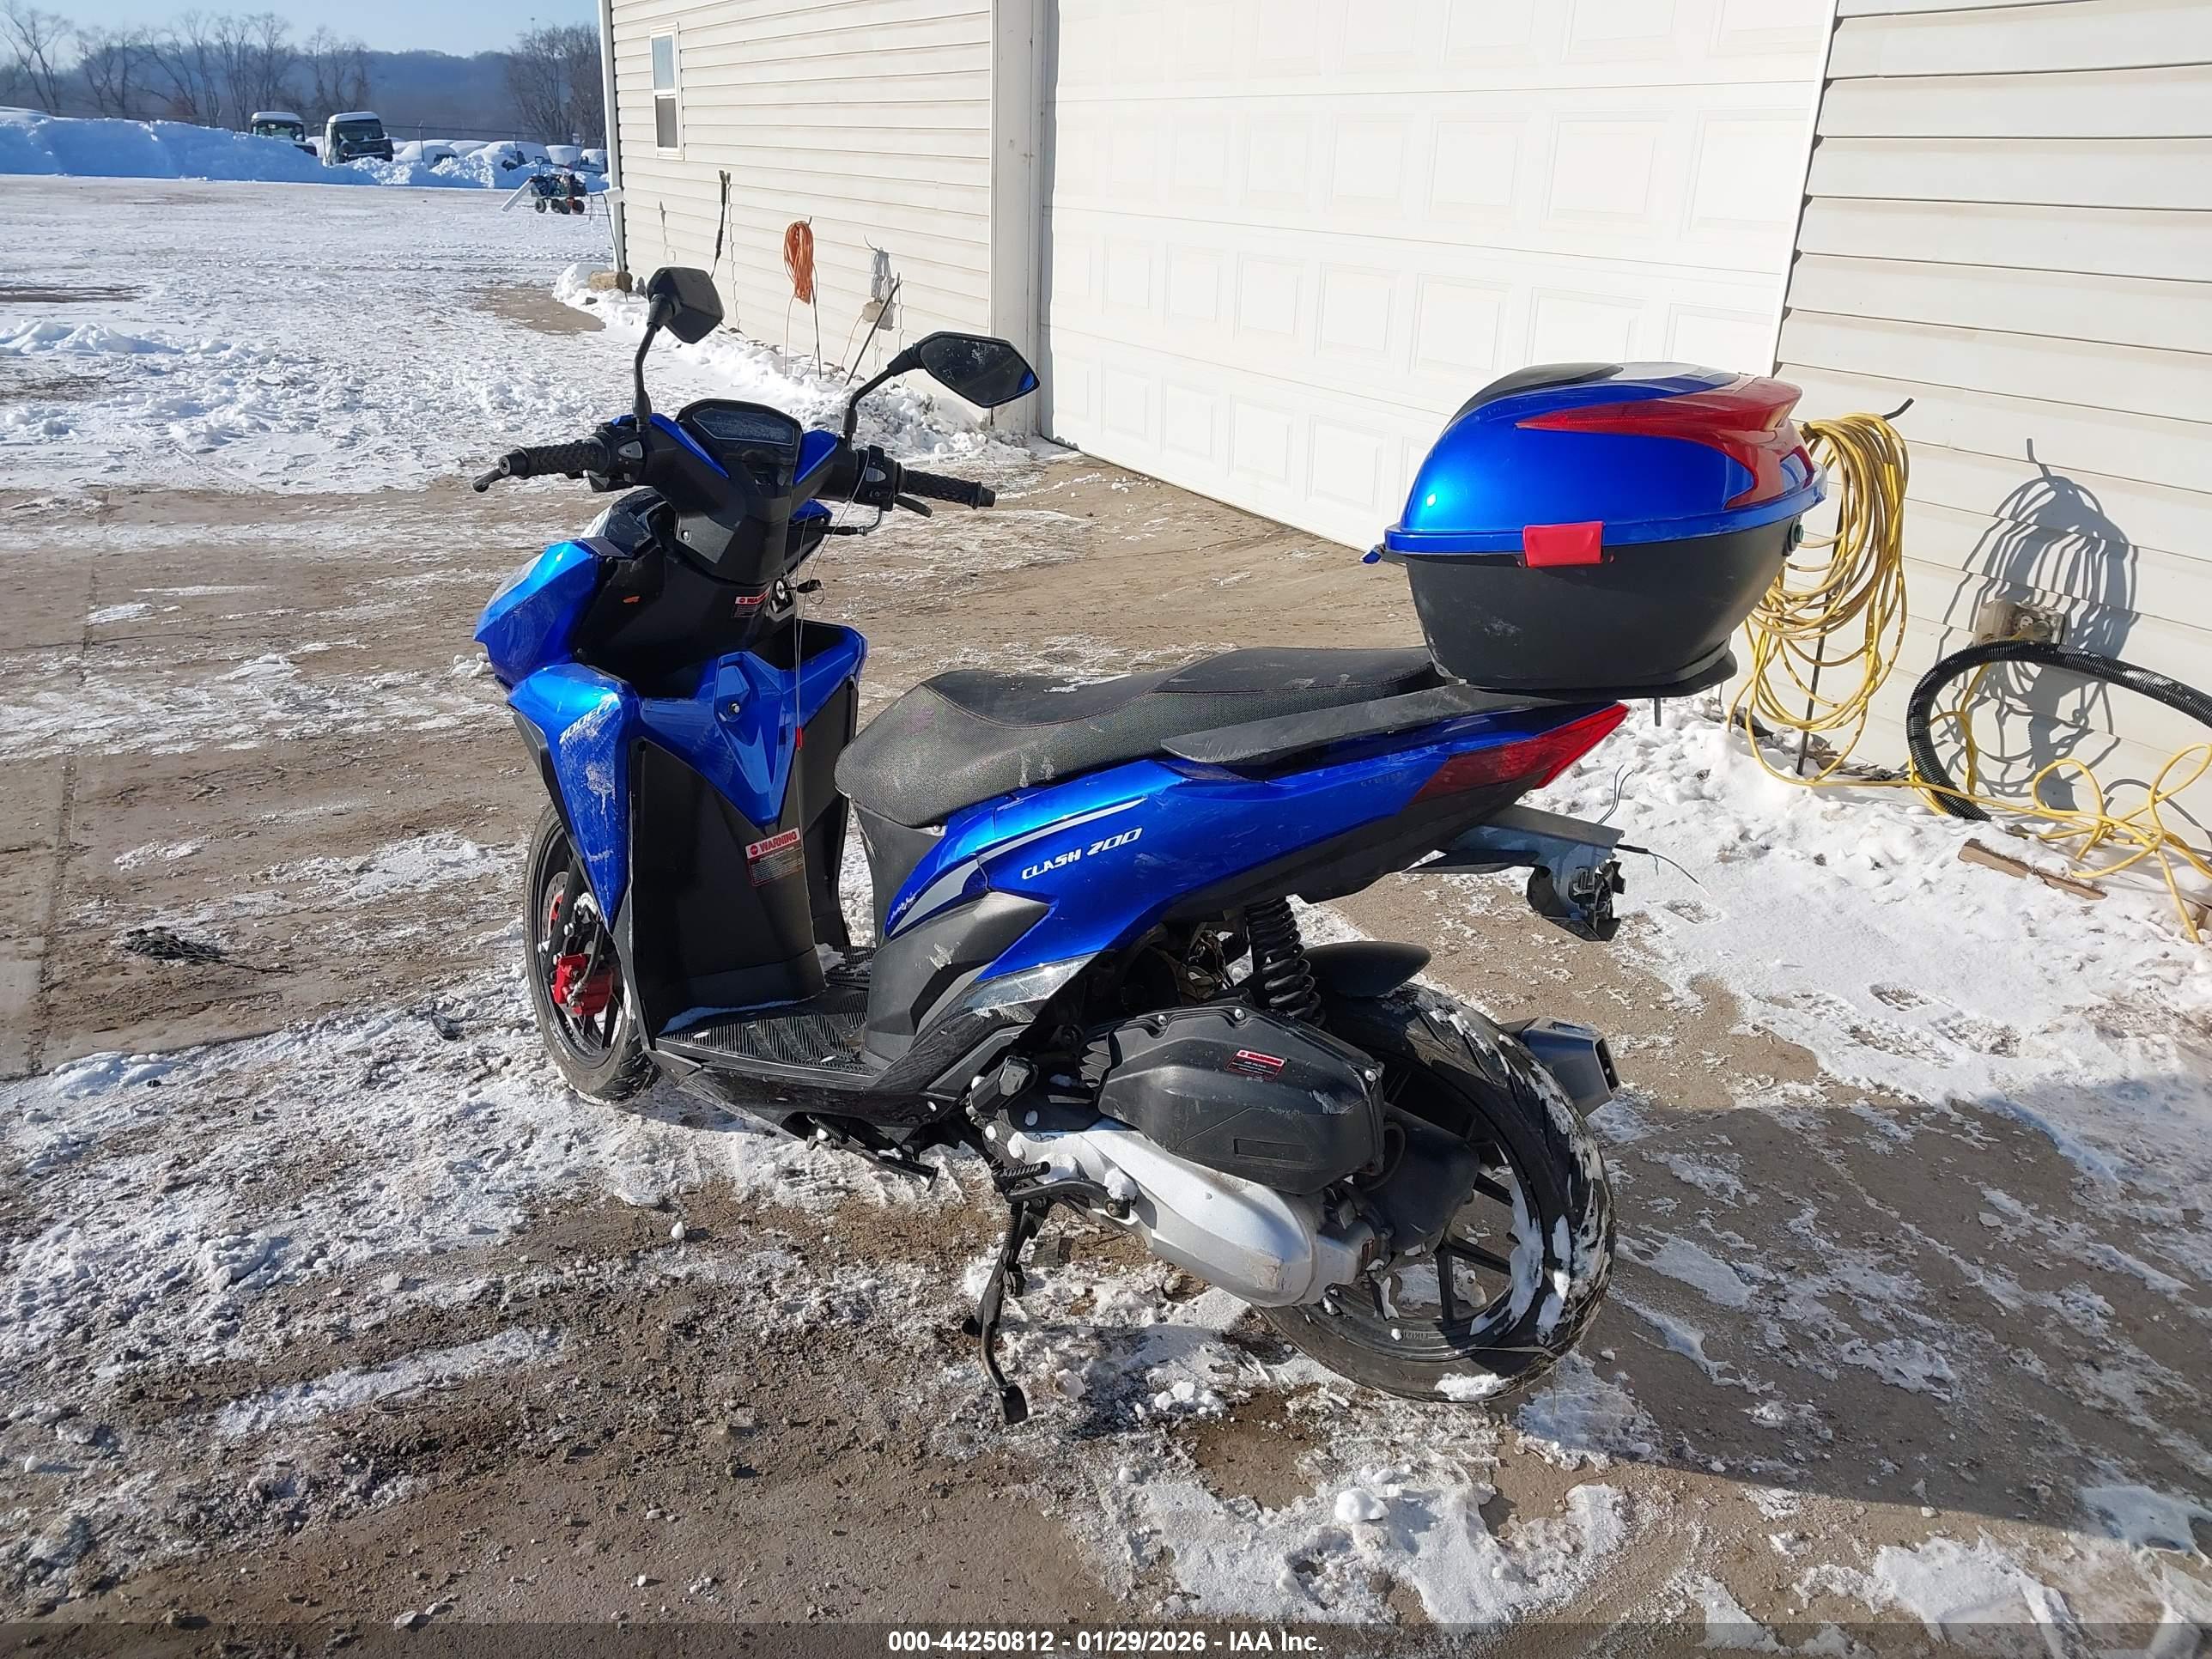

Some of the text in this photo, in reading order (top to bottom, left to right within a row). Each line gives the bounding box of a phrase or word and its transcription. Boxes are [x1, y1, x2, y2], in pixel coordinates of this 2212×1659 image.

[760, 831, 797, 853] WARNING
[1021, 827, 1143, 880] CLASH 200
